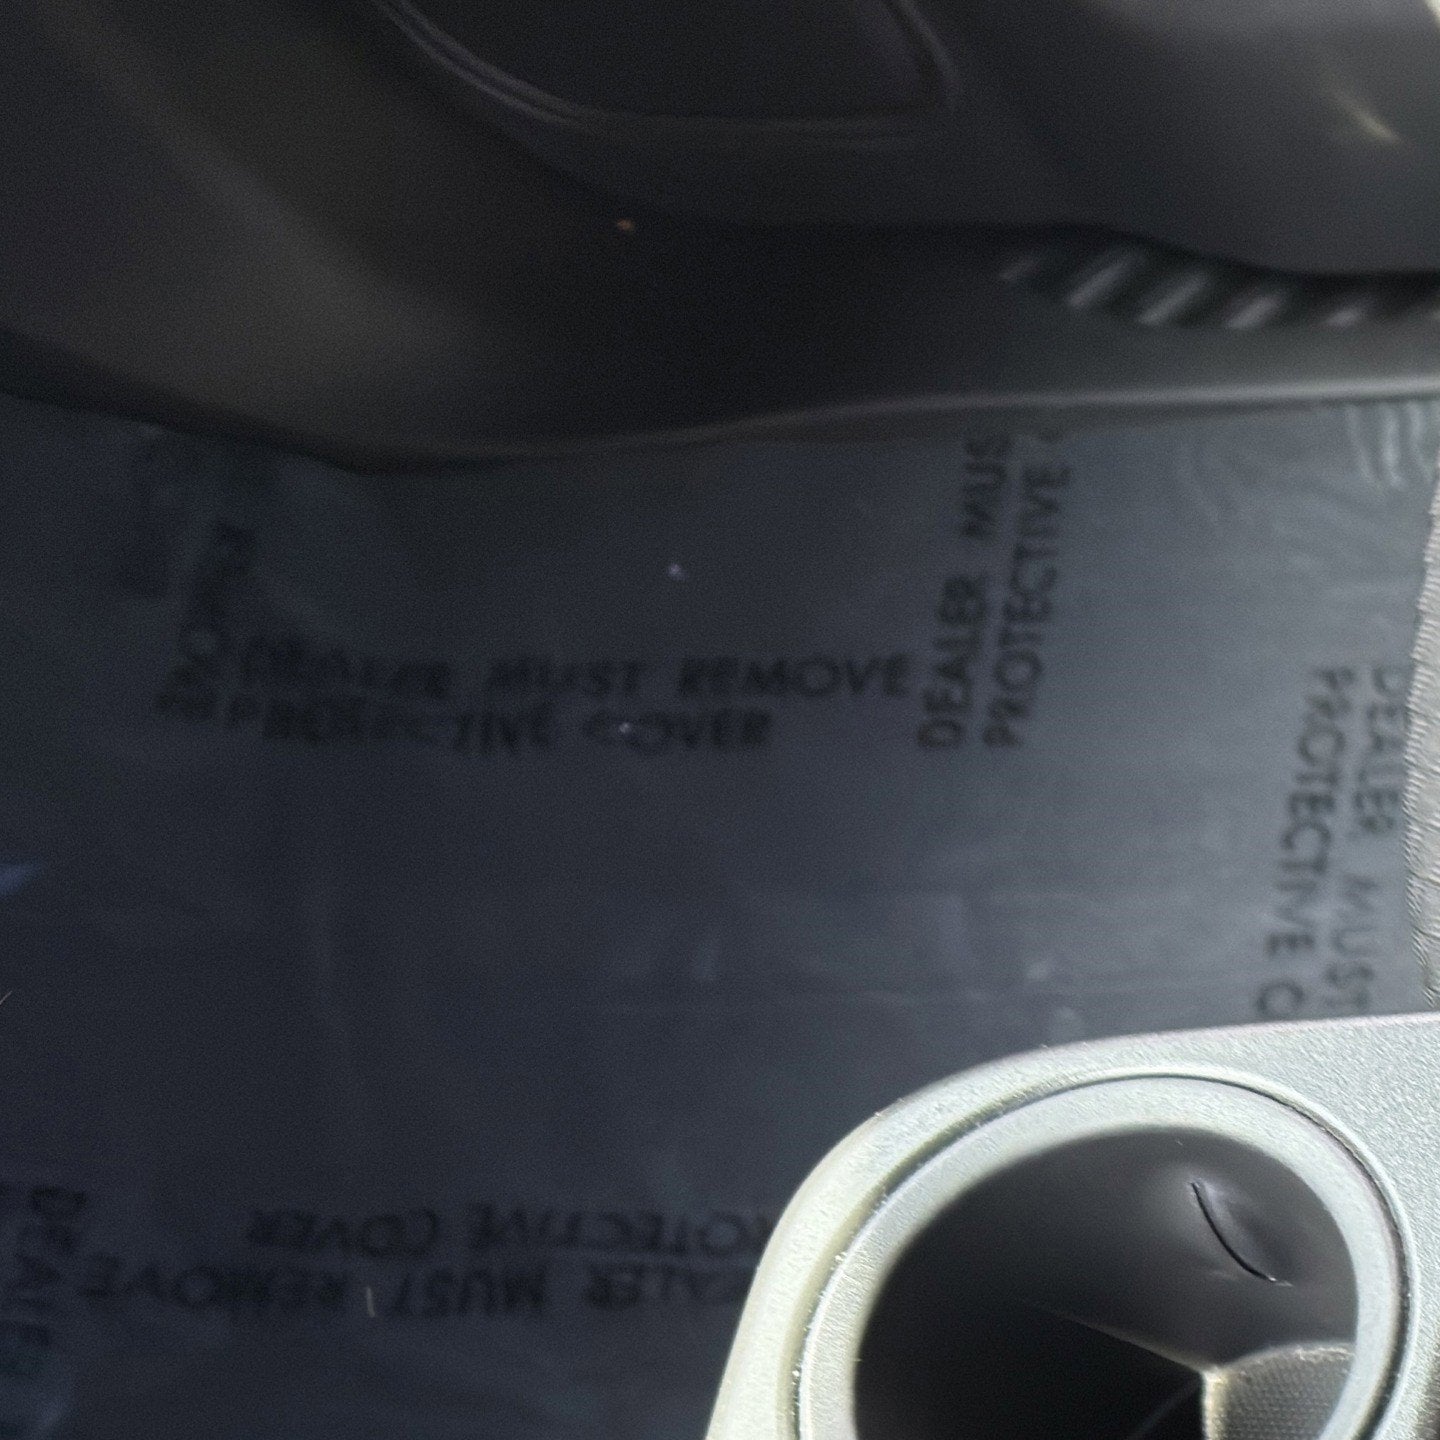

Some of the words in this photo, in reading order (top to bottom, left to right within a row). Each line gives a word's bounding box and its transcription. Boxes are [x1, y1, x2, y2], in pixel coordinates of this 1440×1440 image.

[958, 433, 1010, 540] MUS
[984, 466, 1070, 748] PROTECTIVE
[678, 655, 908, 700] REMOVE
